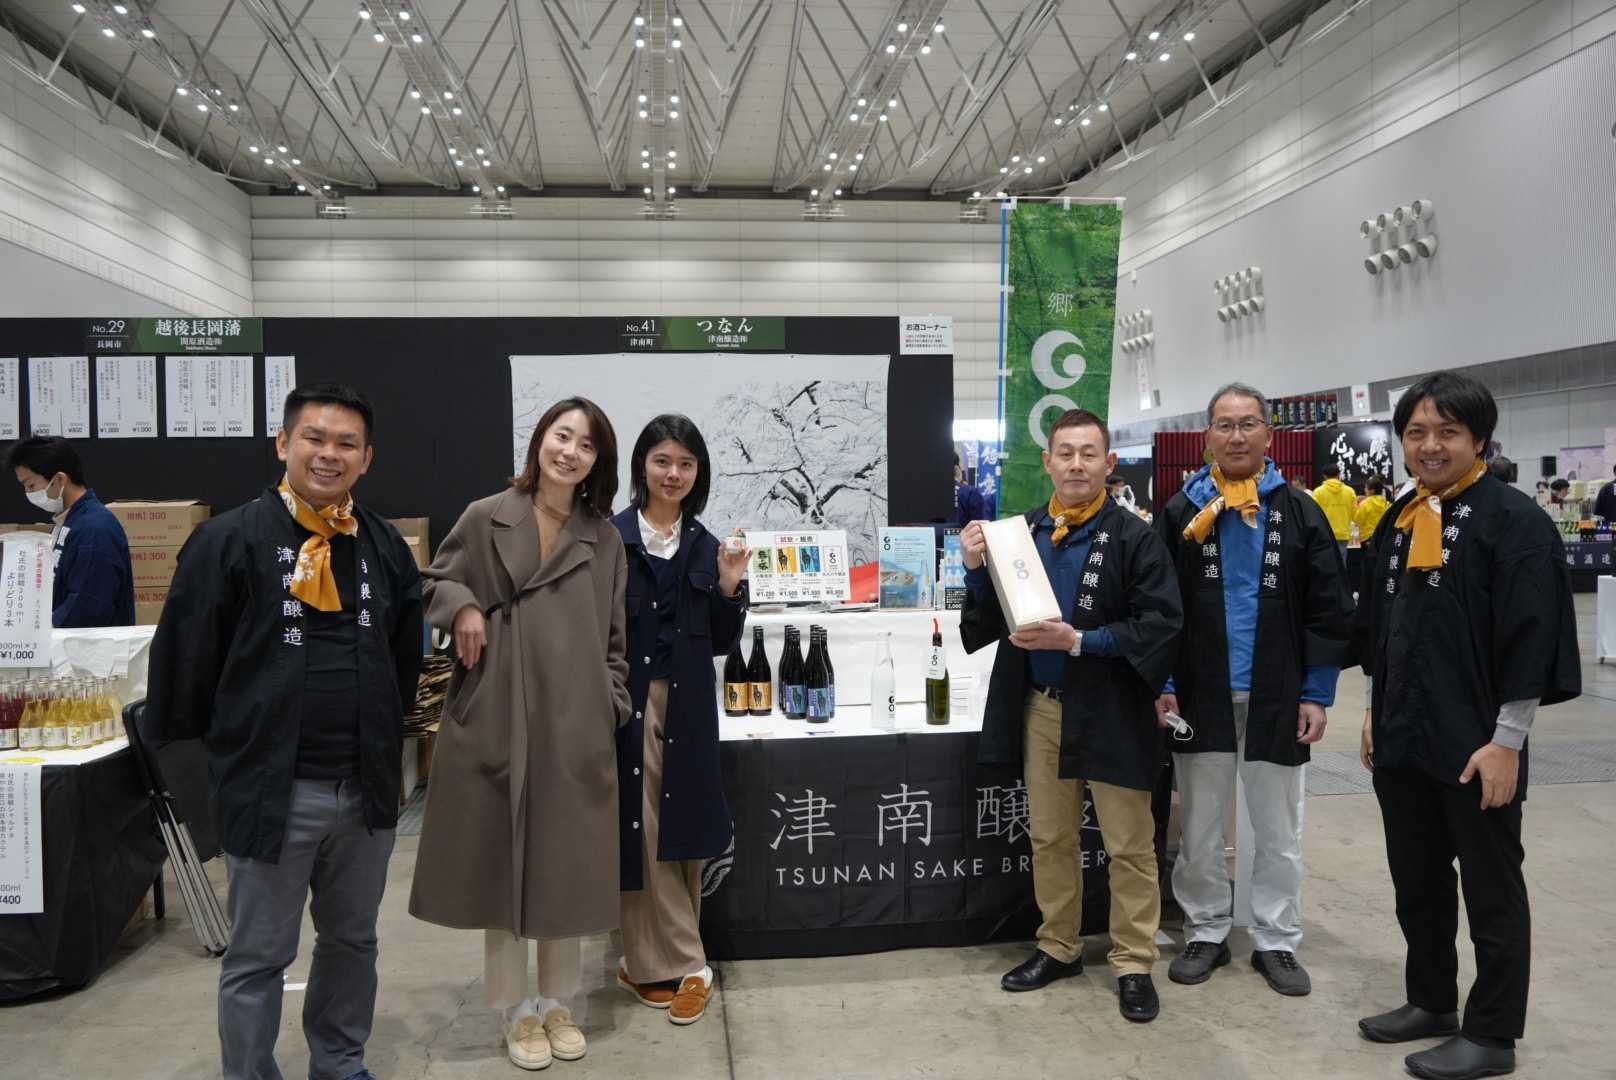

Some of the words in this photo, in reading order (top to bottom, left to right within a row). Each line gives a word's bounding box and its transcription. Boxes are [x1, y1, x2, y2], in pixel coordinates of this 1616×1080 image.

[1047, 292, 1073, 317] 郷
[92, 320, 125, 333] No.29
[155, 319, 241, 336] 越後長岡藩
[626, 320, 655, 332] No.41
[696, 317, 753, 333] つなん
[906, 323, 947, 331] お酒コーナー
[97, 340, 121, 349] 長岡市
[630, 338, 653, 347] 津南町
[1202, 525, 1219, 578] 醸造
[1263, 510, 1283, 589] 津南醸造
[1078, 530, 1112, 610] 津南醸造
[0, 651, 34, 660] ¥1,000
[769, 780, 1102, 855] 津南醸
[776, 861, 897, 887] TSUNAN
[914, 857, 985, 879] SAKE
[1001, 850, 1107, 874] BRER
